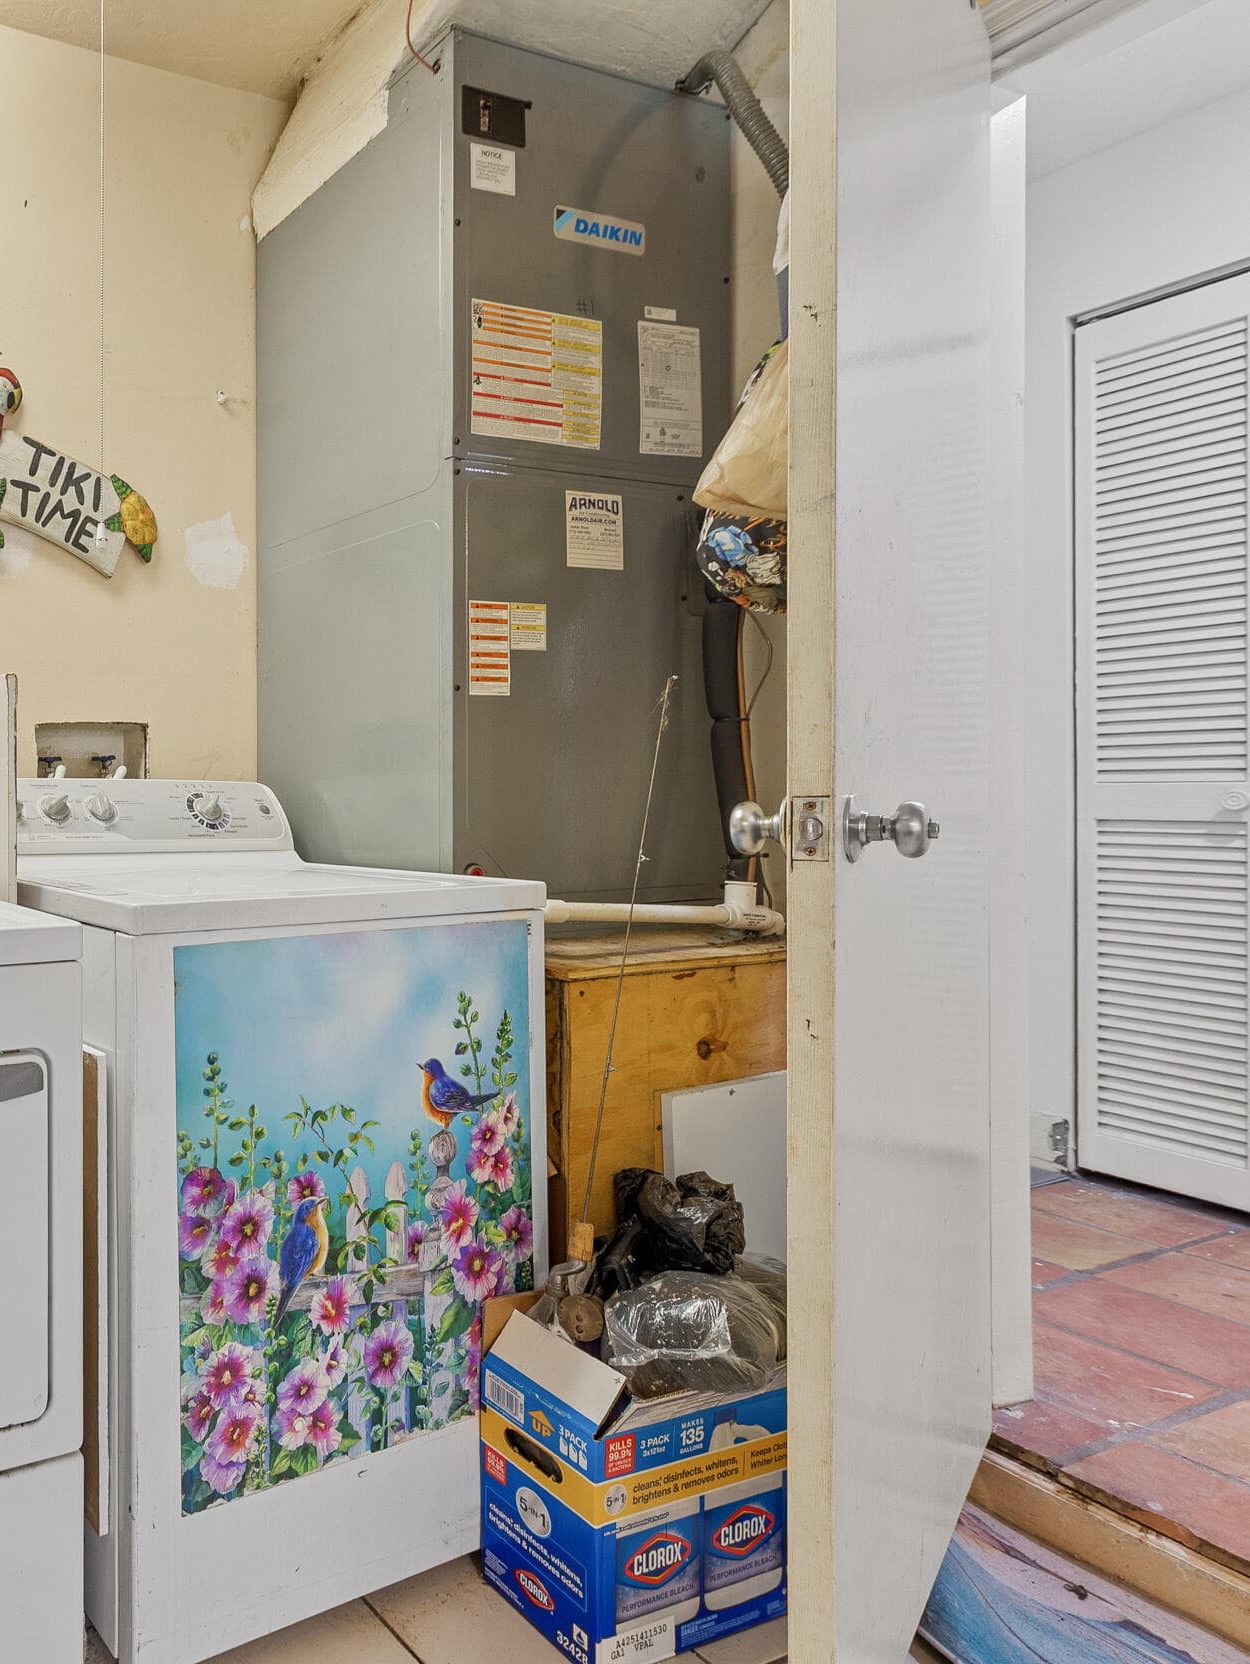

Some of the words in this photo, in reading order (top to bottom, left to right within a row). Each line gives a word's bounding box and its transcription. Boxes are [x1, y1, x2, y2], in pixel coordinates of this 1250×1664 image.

[481, 149, 503, 160] NOTICE
[573, 217, 643, 247] DAIKIN
[22, 435, 102, 513] TIKI
[9, 479, 99, 554] TIME
[569, 497, 619, 515] ARNOLD
[532, 1417, 552, 1437] UP
[680, 1417, 705, 1429] MAKES
[680, 1425, 705, 1447] 135
[558, 1424, 565, 1436] 3
[565, 1428, 588, 1453] PACK
[609, 1438, 632, 1452] KILLS
[640, 1439, 646, 1449] 3
[646, 1433, 670, 1448] PACK
[679, 1442, 704, 1455] GALLONS
[750, 1446, 772, 1459] Keeps
[608, 1448, 632, 1462] 99.9%
[750, 1457, 773, 1470] Whiter
[663, 1466, 705, 1485] disinfects,
[705, 1456, 738, 1472] whitens,
[632, 1485, 672, 1505] brightens
[673, 1482, 680, 1493] &
[681, 1473, 716, 1491] removes
[716, 1465, 740, 1480] odors
[720, 1513, 767, 1547] CLOROX
[489, 1511, 521, 1545] brightens
[521, 1539, 528, 1551] &
[528, 1547, 561, 1579] removes
[560, 1574, 584, 1599] odors
[513, 1522, 551, 1560] disinfects,
[550, 1553, 583, 1588] whitens,
[633, 1541, 683, 1576] CLOROX
[709, 1560, 753, 1582] PERFORMANCE
[753, 1554, 778, 1568] BLEACH
[519, 1573, 549, 1606] CLOROX
[621, 1590, 669, 1614] PERFORMANCE
[669, 1583, 695, 1596] BLEACH
[615, 1622, 668, 1650] A4251411530
[610, 1646, 626, 1661] GA1
[634, 1640, 654, 1653] VPAL
